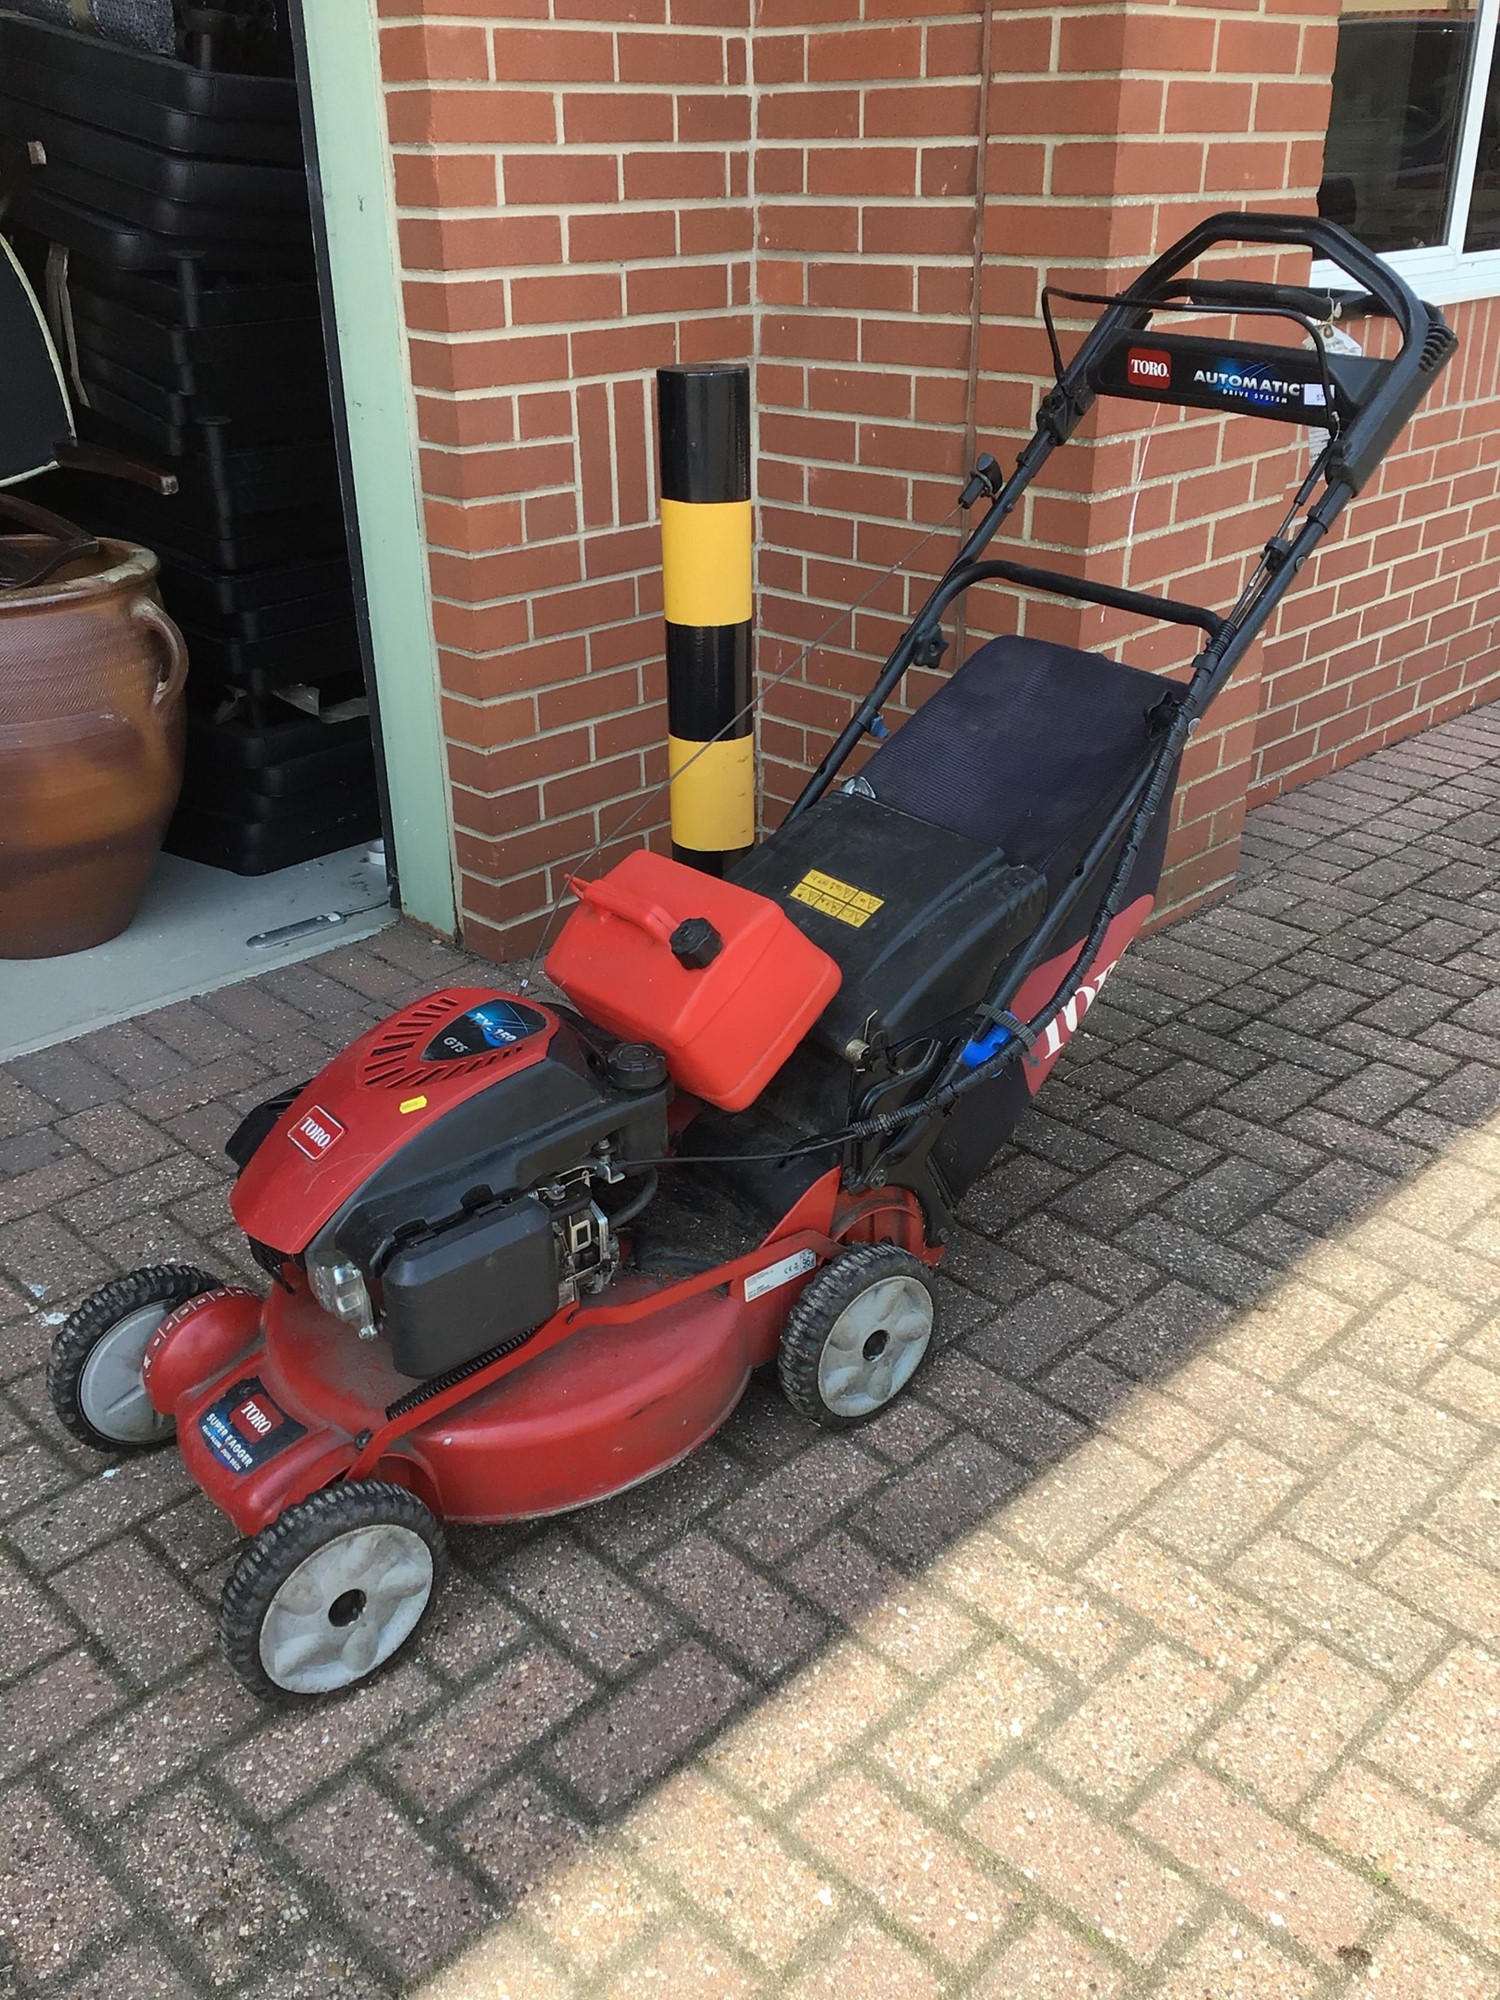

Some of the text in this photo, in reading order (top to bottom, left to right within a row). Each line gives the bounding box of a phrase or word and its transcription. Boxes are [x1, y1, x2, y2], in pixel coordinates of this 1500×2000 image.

[1131, 359, 1169, 378] TORO
[1193, 370, 1301, 396] AUTOMATIC
[1222, 388, 1288, 404] DRIVE SYSTEM
[443, 1037, 468, 1053] GTS
[300, 1116, 331, 1148] TORO
[206, 1413, 229, 1437] SUPER
[241, 1401, 272, 1434] TORO
